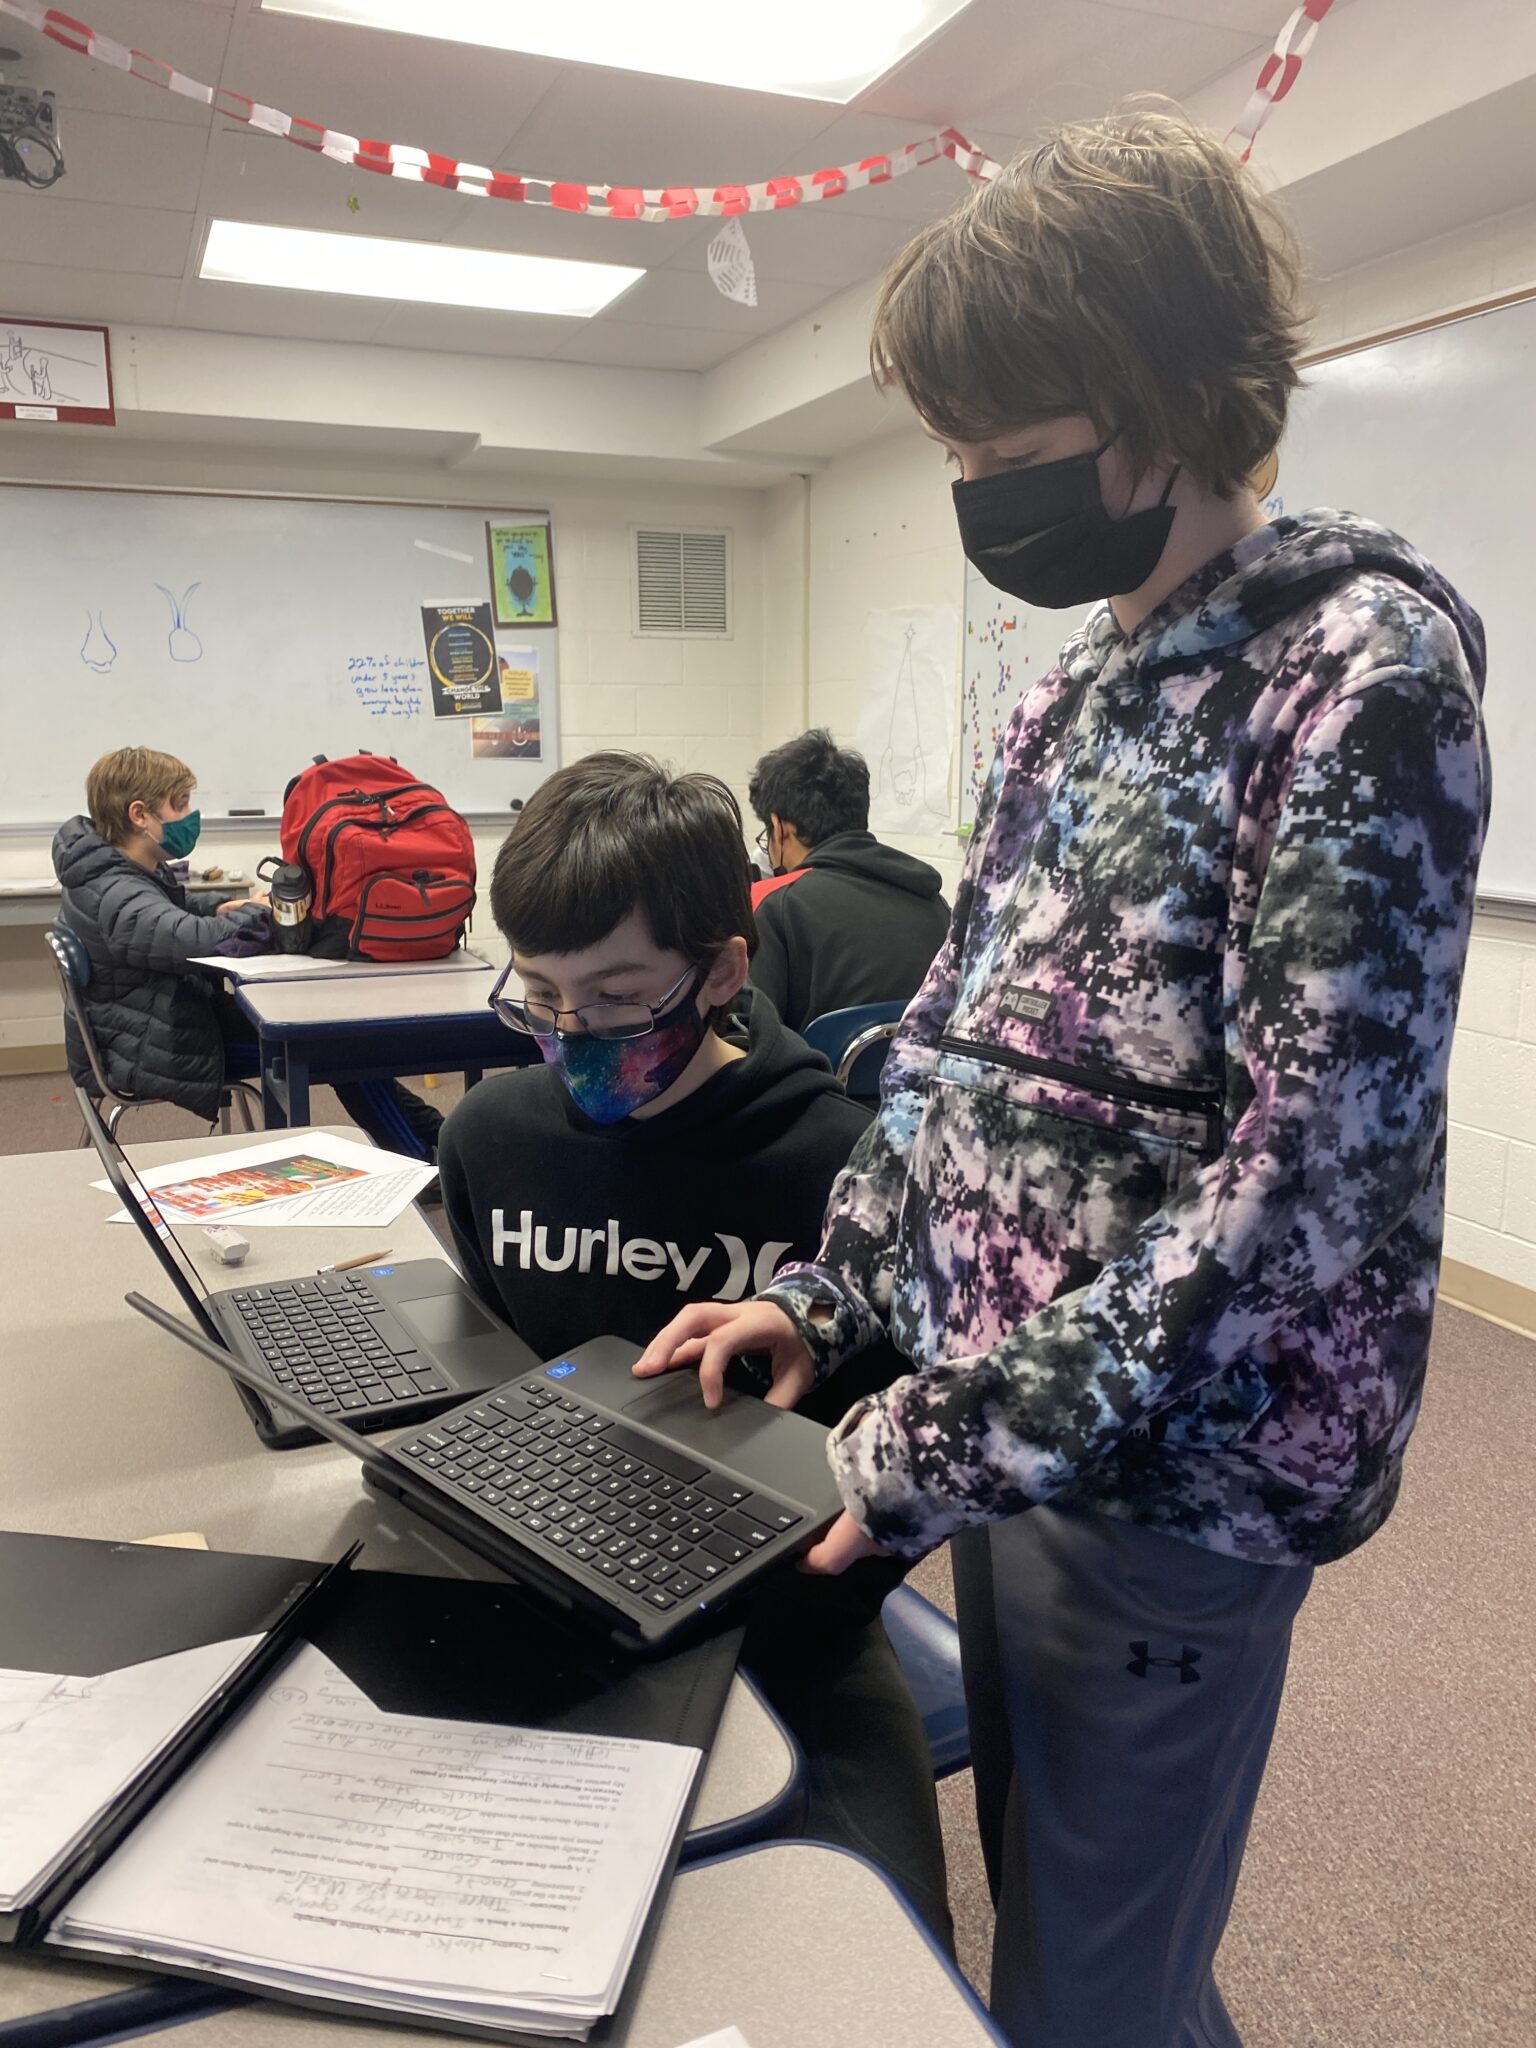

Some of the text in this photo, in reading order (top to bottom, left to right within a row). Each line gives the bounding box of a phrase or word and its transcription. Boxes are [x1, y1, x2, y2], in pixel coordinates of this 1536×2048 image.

[348, 656, 376, 670] 22%
[1021, 997, 1048, 1009] CONTROLLER
[1023, 1005, 1039, 1015] POCKET
[492, 1208, 712, 1292] Hurley
[448, 1773, 498, 1785] Introduction
[541, 1782, 581, 1792] Biography
[584, 1786, 622, 1796] Narrative
[512, 1832, 558, 1842] interviewed
